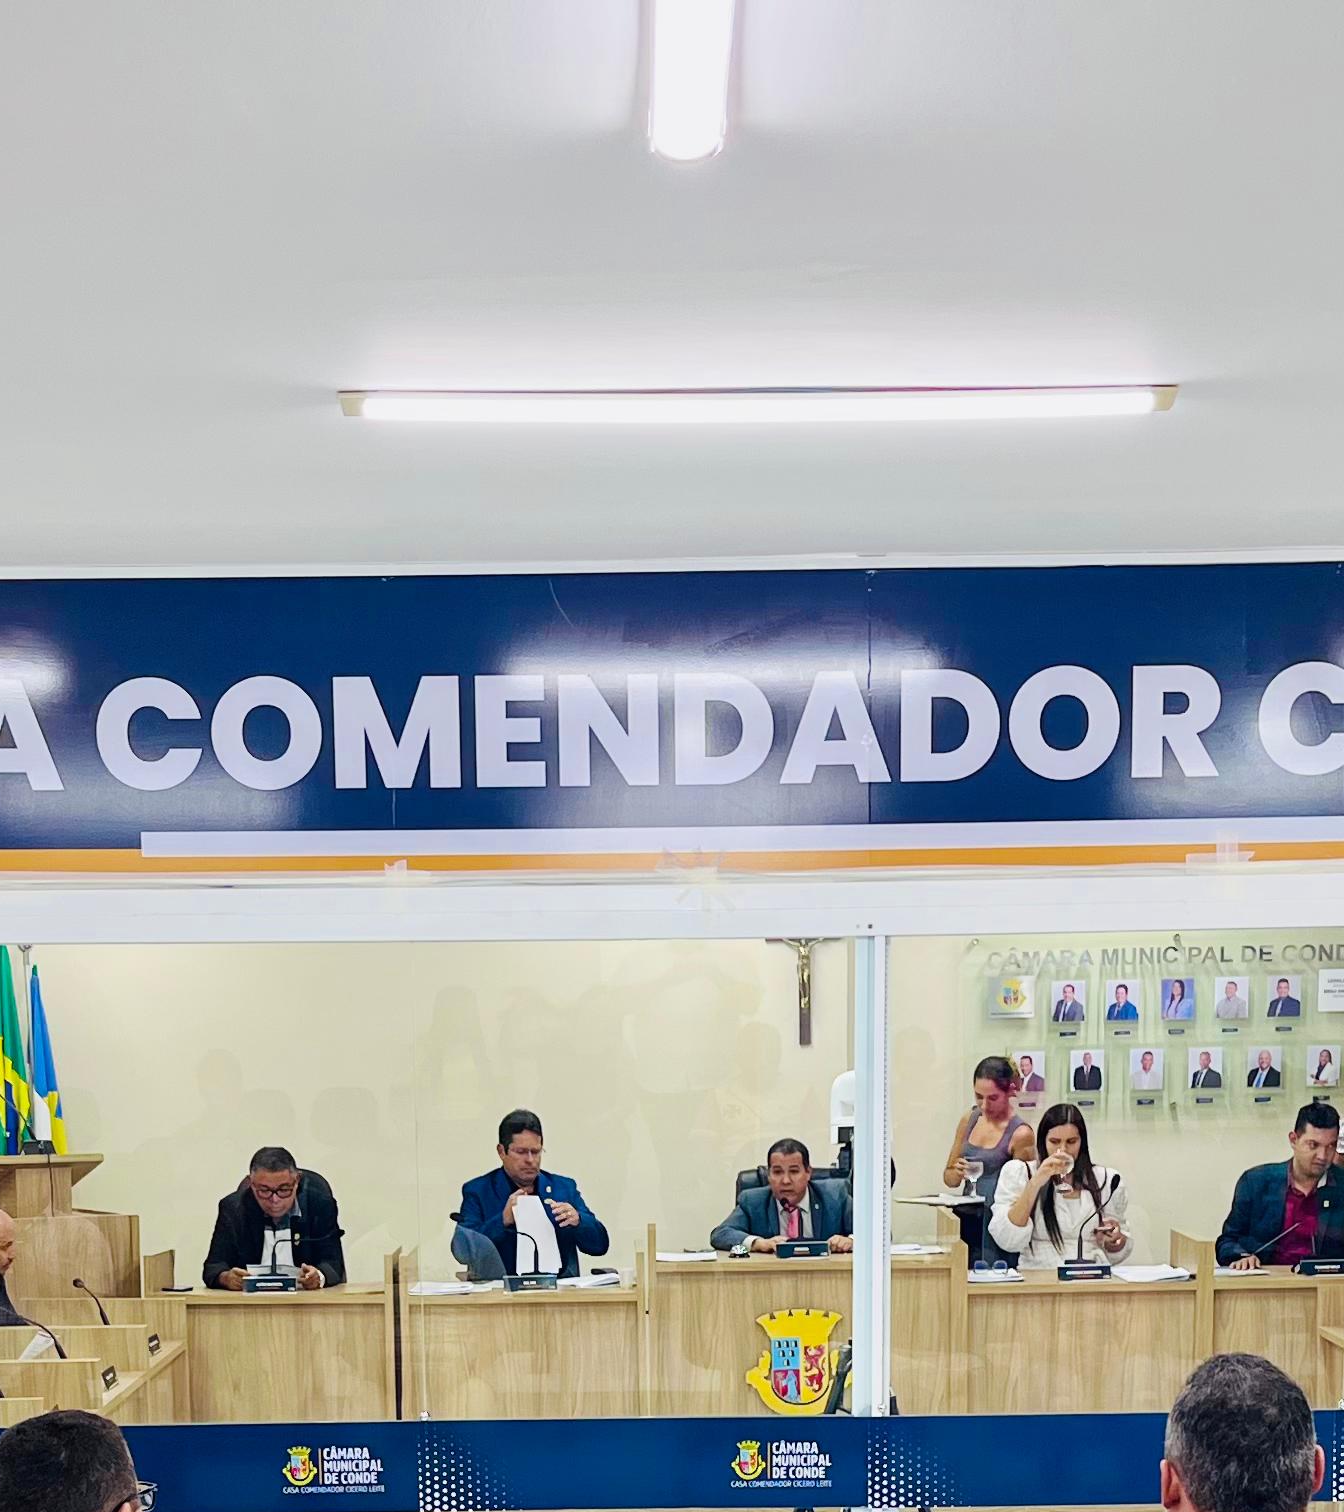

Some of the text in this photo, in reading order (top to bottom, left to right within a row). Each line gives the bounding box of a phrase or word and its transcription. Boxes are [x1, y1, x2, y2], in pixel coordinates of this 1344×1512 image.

[95, 665, 1223, 792] COMENDADOR
[987, 947, 1094, 969] CÂMARA
[1101, 945, 1233, 966] MUNICIPAL
[1241, 945, 1274, 963] DE
[323, 1445, 370, 1460] CÂMARA
[772, 1440, 818, 1455] CÂMARA
[323, 1459, 384, 1472] MUNICIPAL
[772, 1454, 832, 1467] MUNICIPAL
[324, 1472, 378, 1485] DE CONDE
[772, 1466, 826, 1479] DE CONDE
